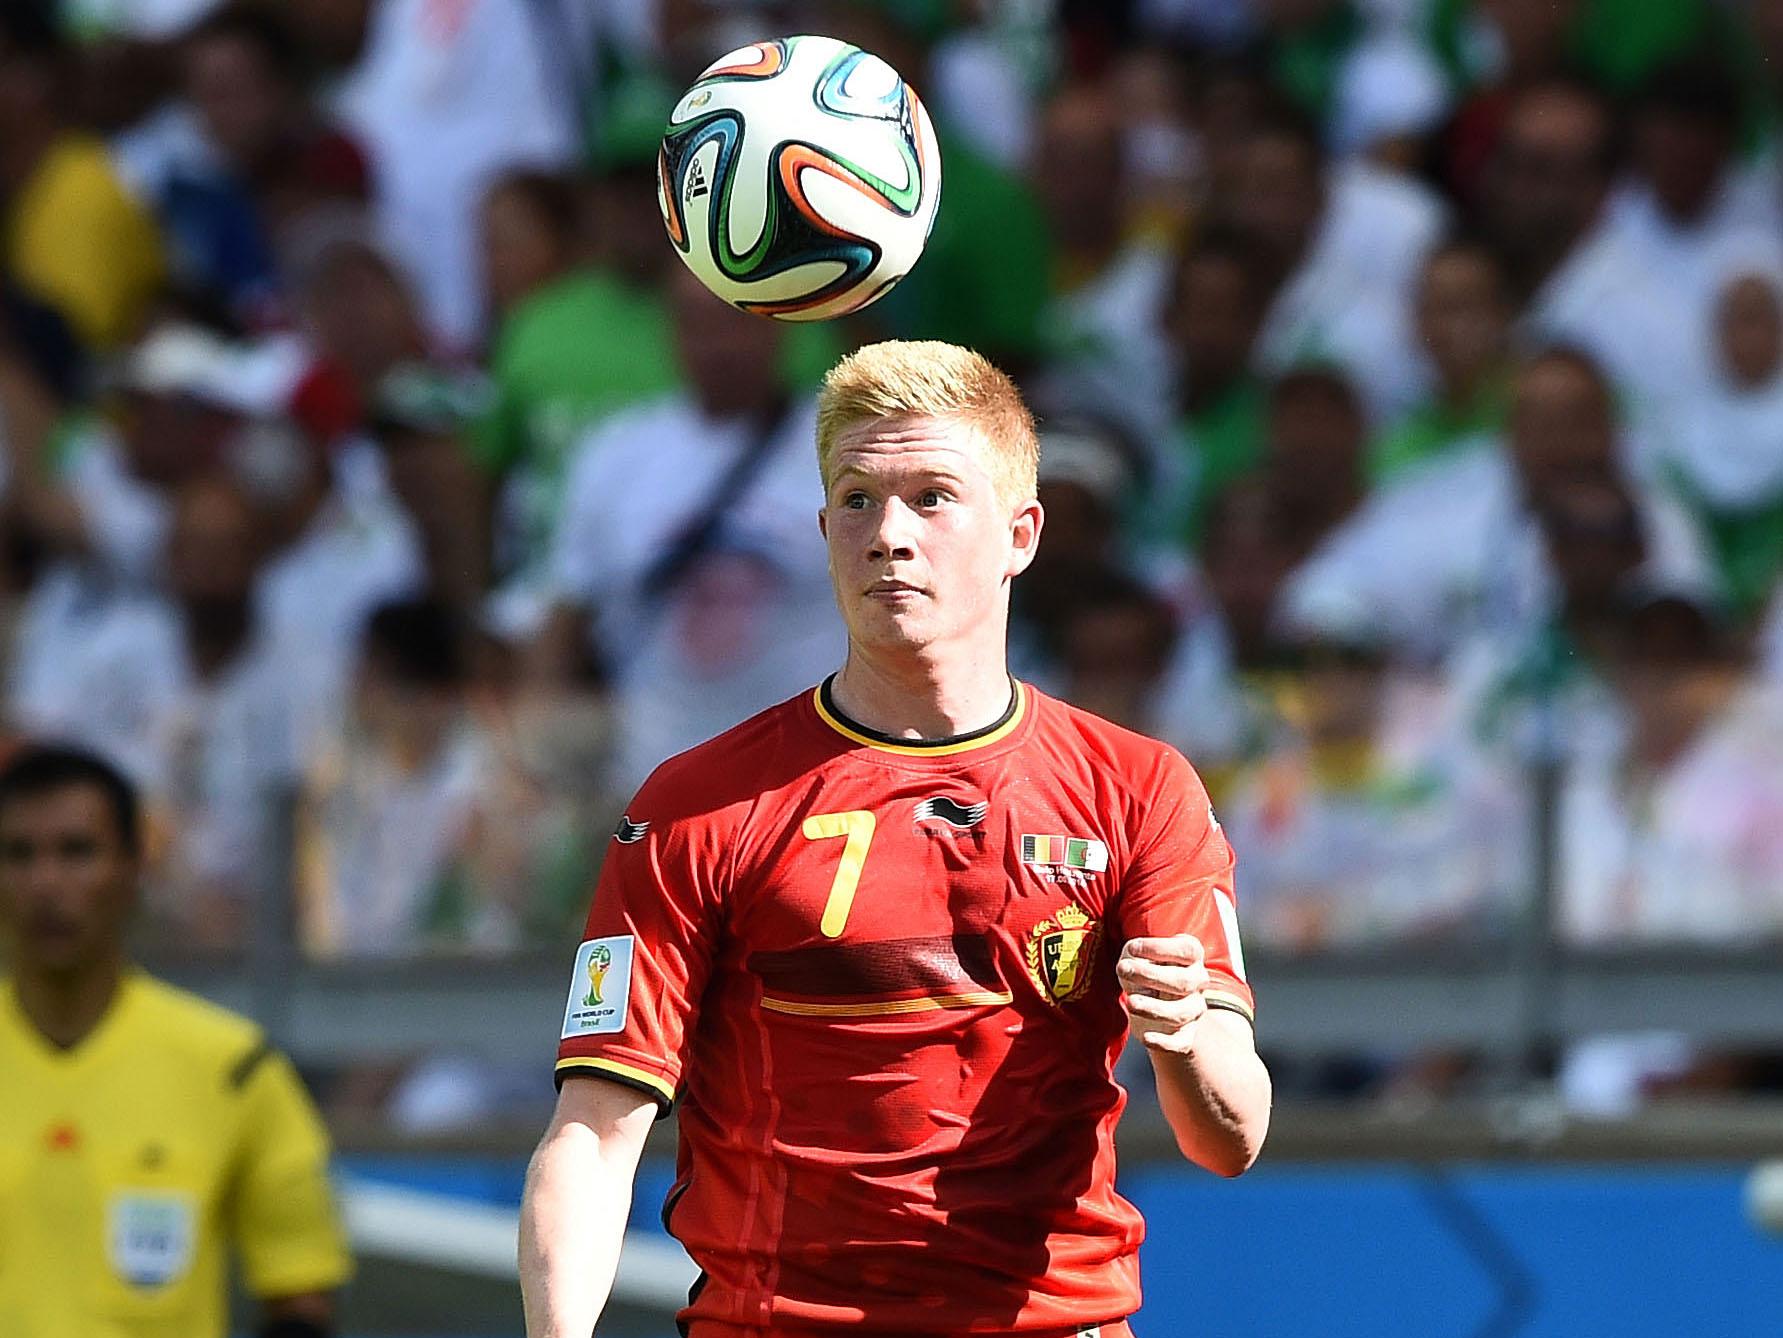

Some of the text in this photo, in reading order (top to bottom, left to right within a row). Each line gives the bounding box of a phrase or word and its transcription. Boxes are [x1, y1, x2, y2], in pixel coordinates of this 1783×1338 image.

[685, 158, 699, 202] adidas
[802, 810, 876, 938] 7
[582, 1010, 601, 1018] WORLD
